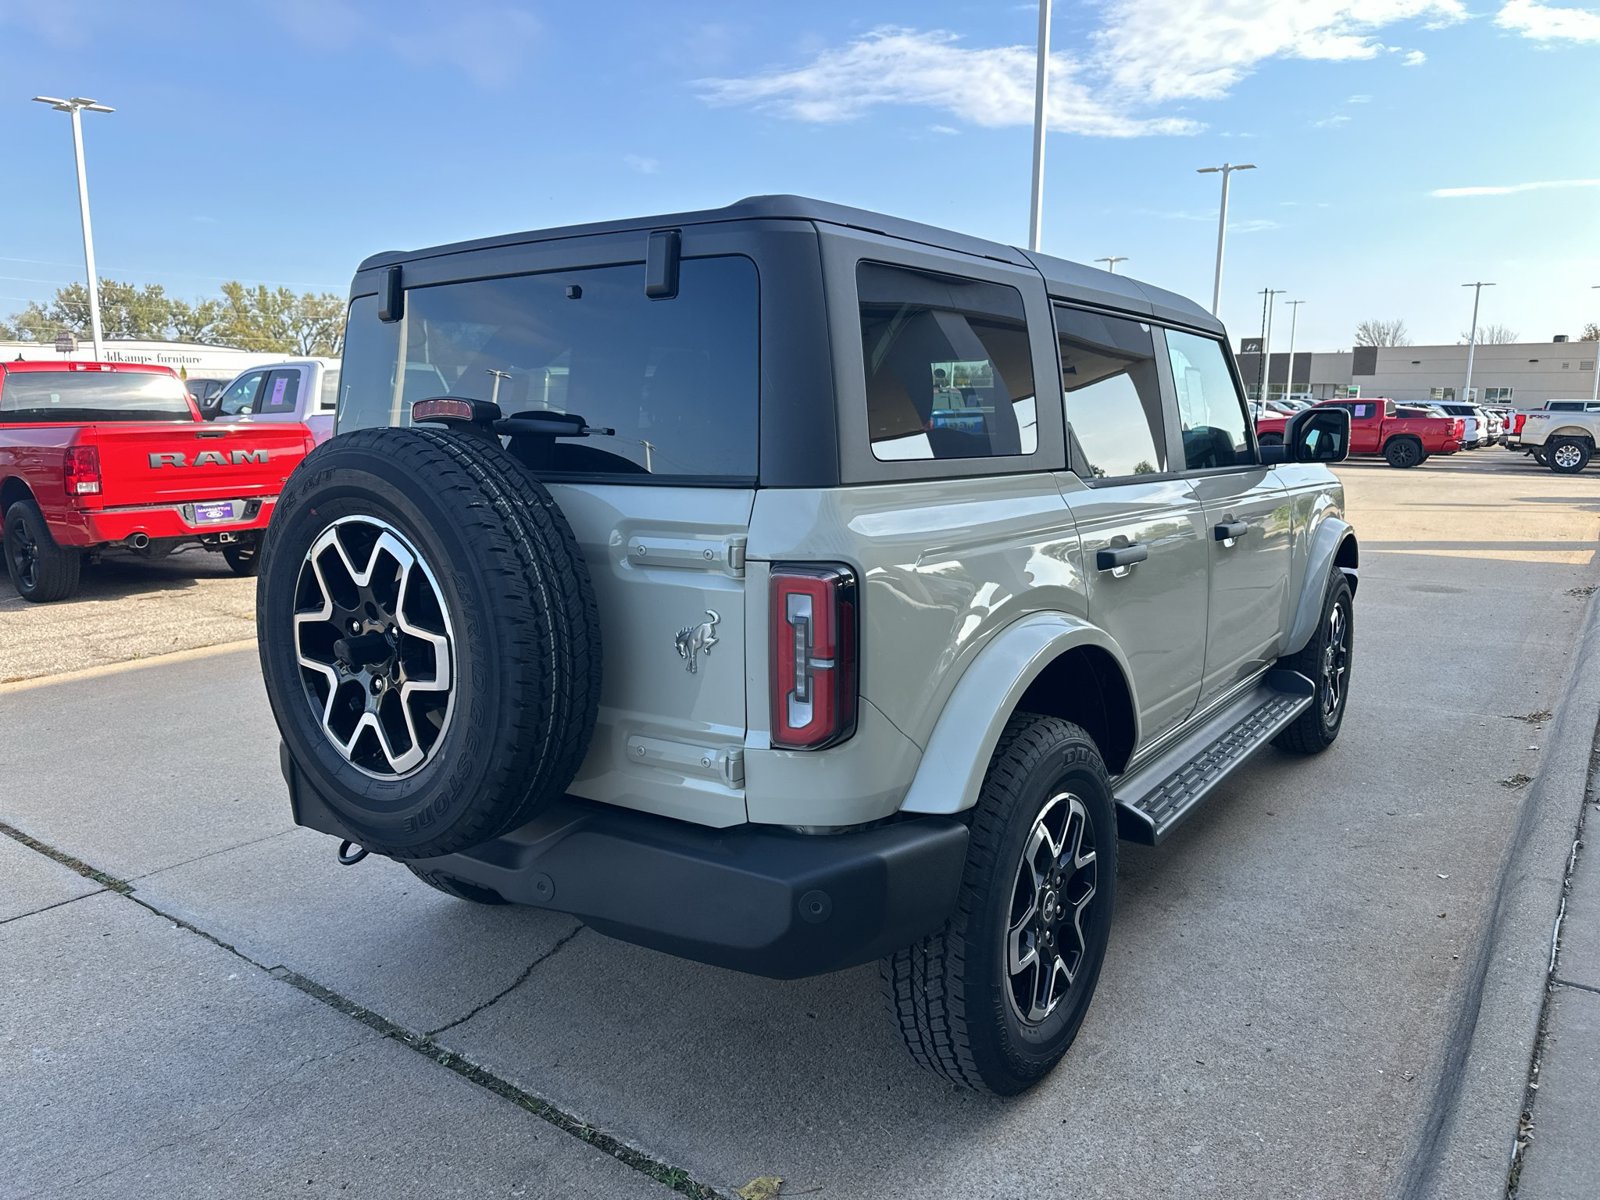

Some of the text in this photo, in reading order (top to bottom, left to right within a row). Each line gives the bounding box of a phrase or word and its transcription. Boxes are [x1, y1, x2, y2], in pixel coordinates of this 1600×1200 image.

[157, 353, 202, 364] furniture
[148, 449, 270, 469] RAM
[404, 572, 488, 833] BRIDGESTONE
